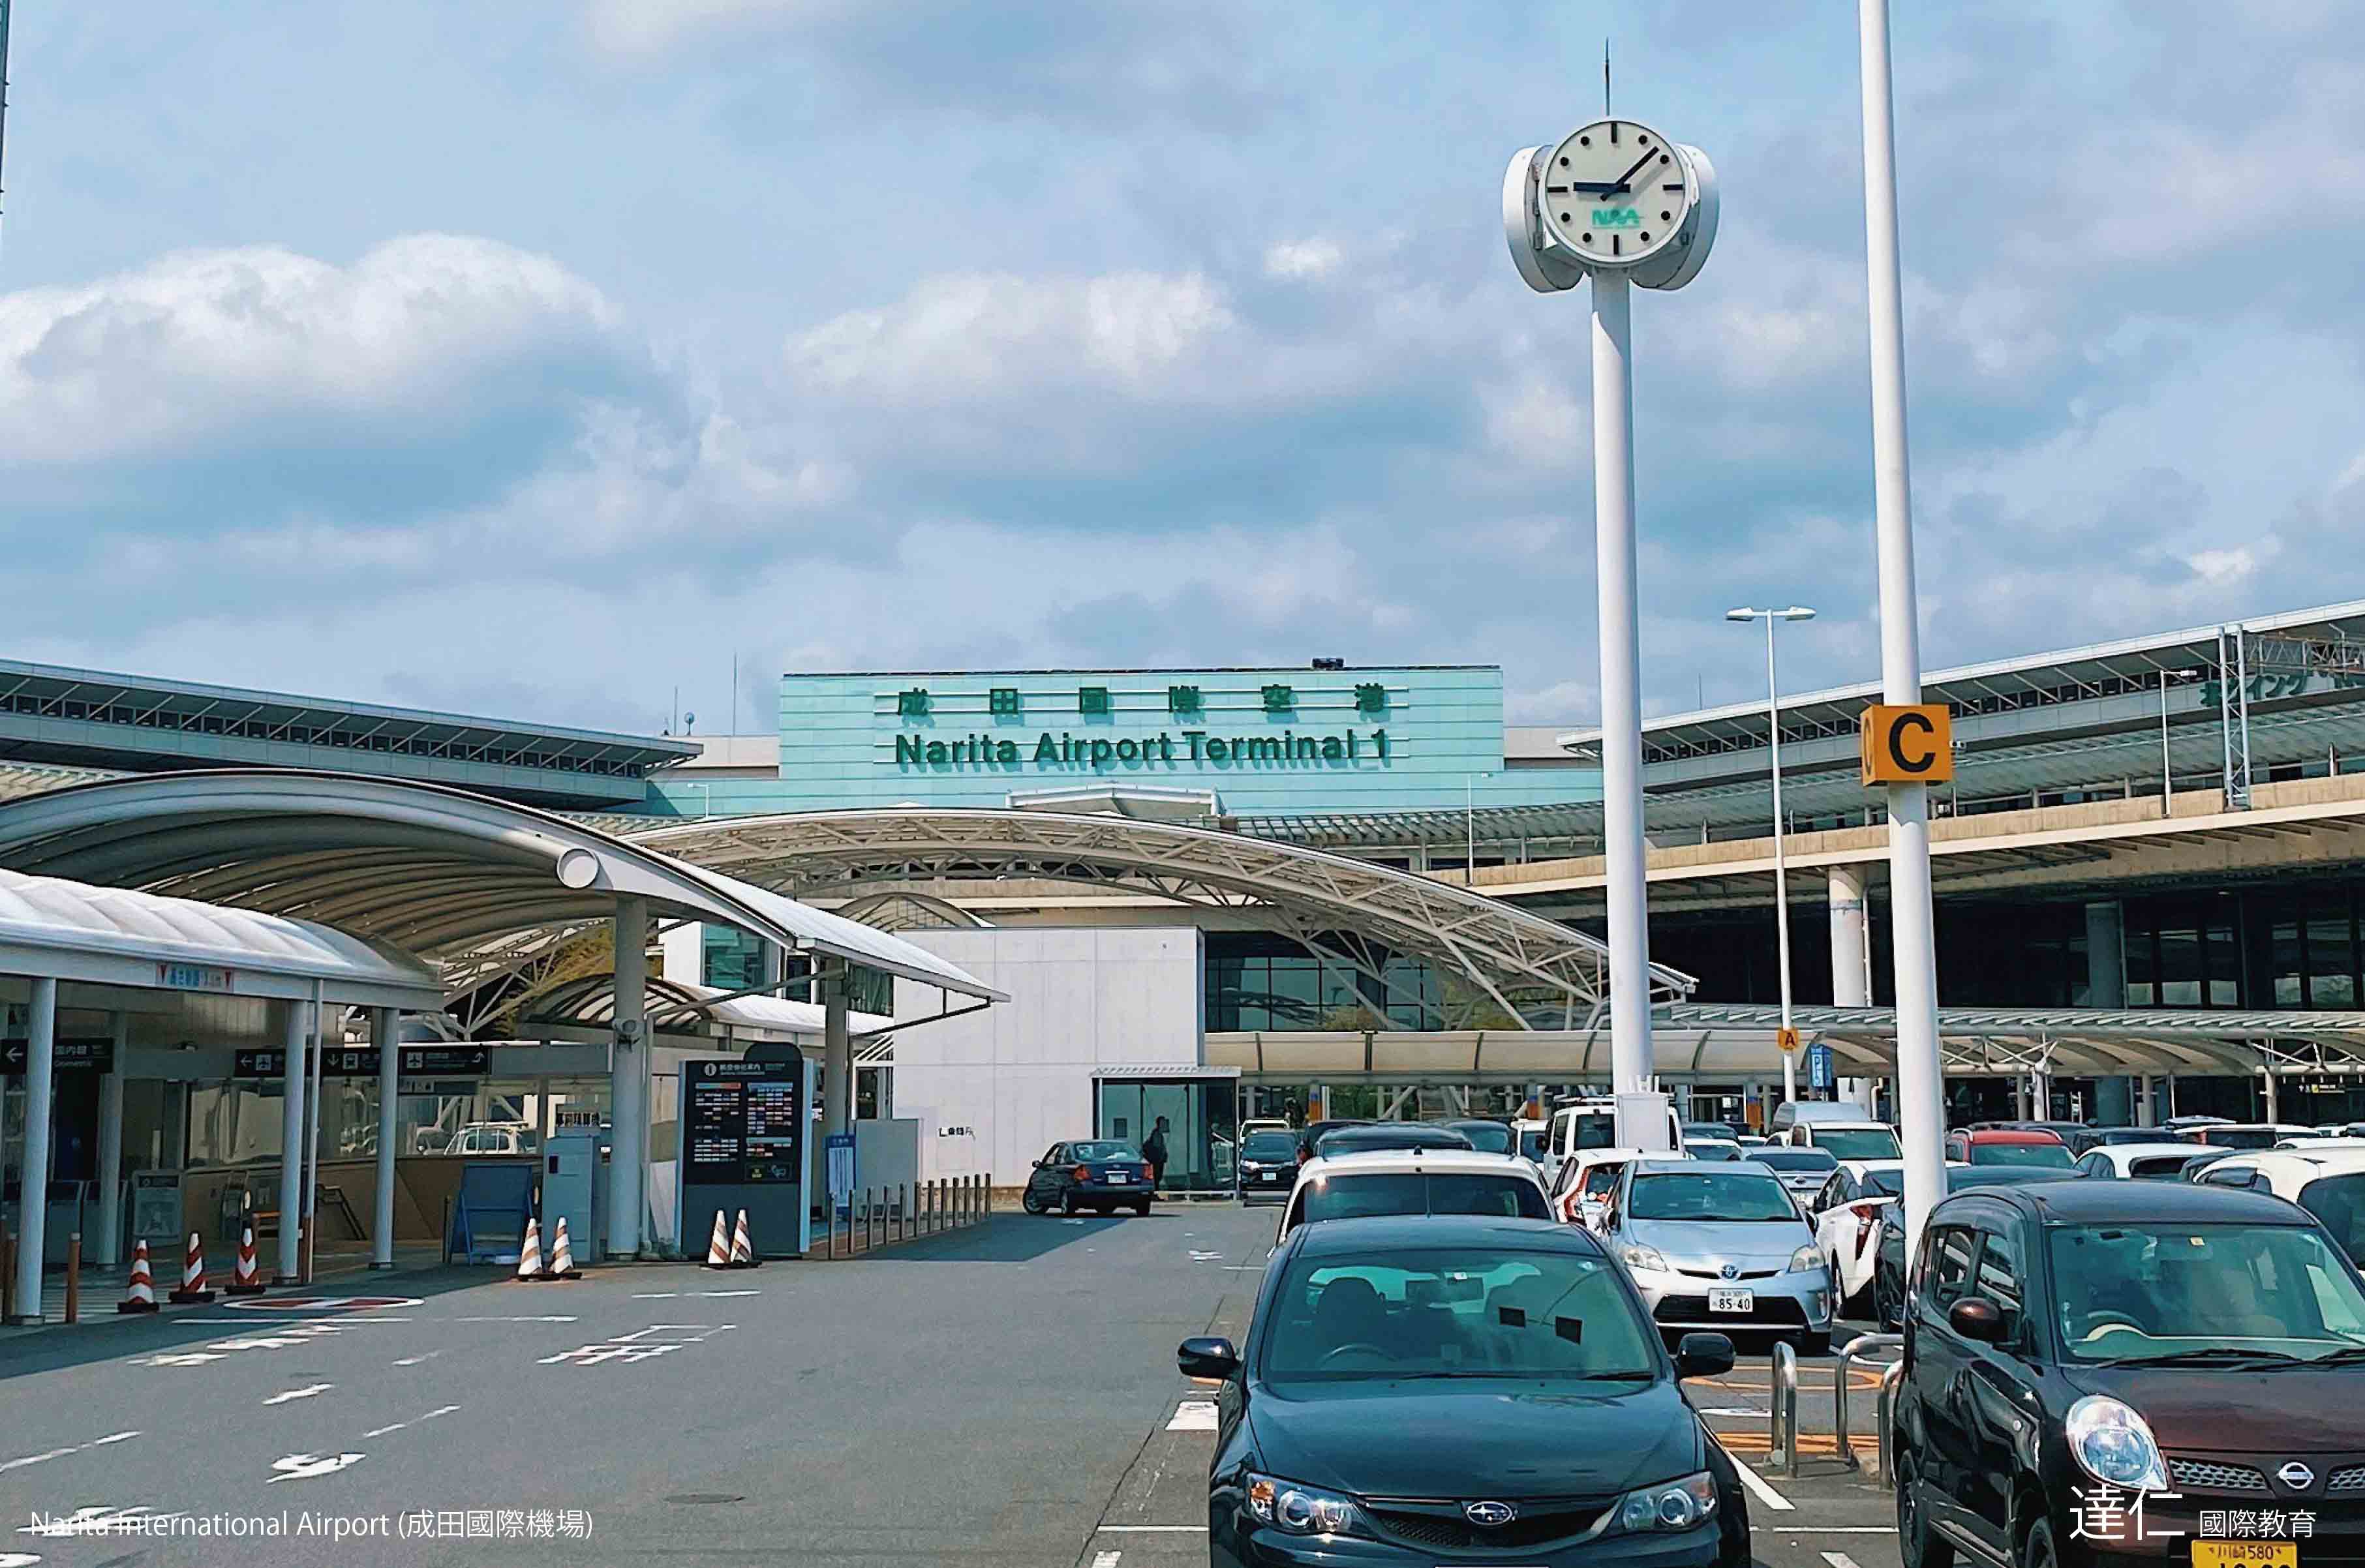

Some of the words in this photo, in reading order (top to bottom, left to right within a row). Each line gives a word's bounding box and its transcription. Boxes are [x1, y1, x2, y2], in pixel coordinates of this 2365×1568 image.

[898, 682, 1384, 715] 成田国際空港
[896, 733, 1018, 763] Narita
[1033, 732, 1171, 767] Airport
[1182, 729, 1353, 761] Terminal
[1371, 729, 1384, 759] 1
[1889, 712, 1936, 773] C
[1785, 1032, 1796, 1046] A
